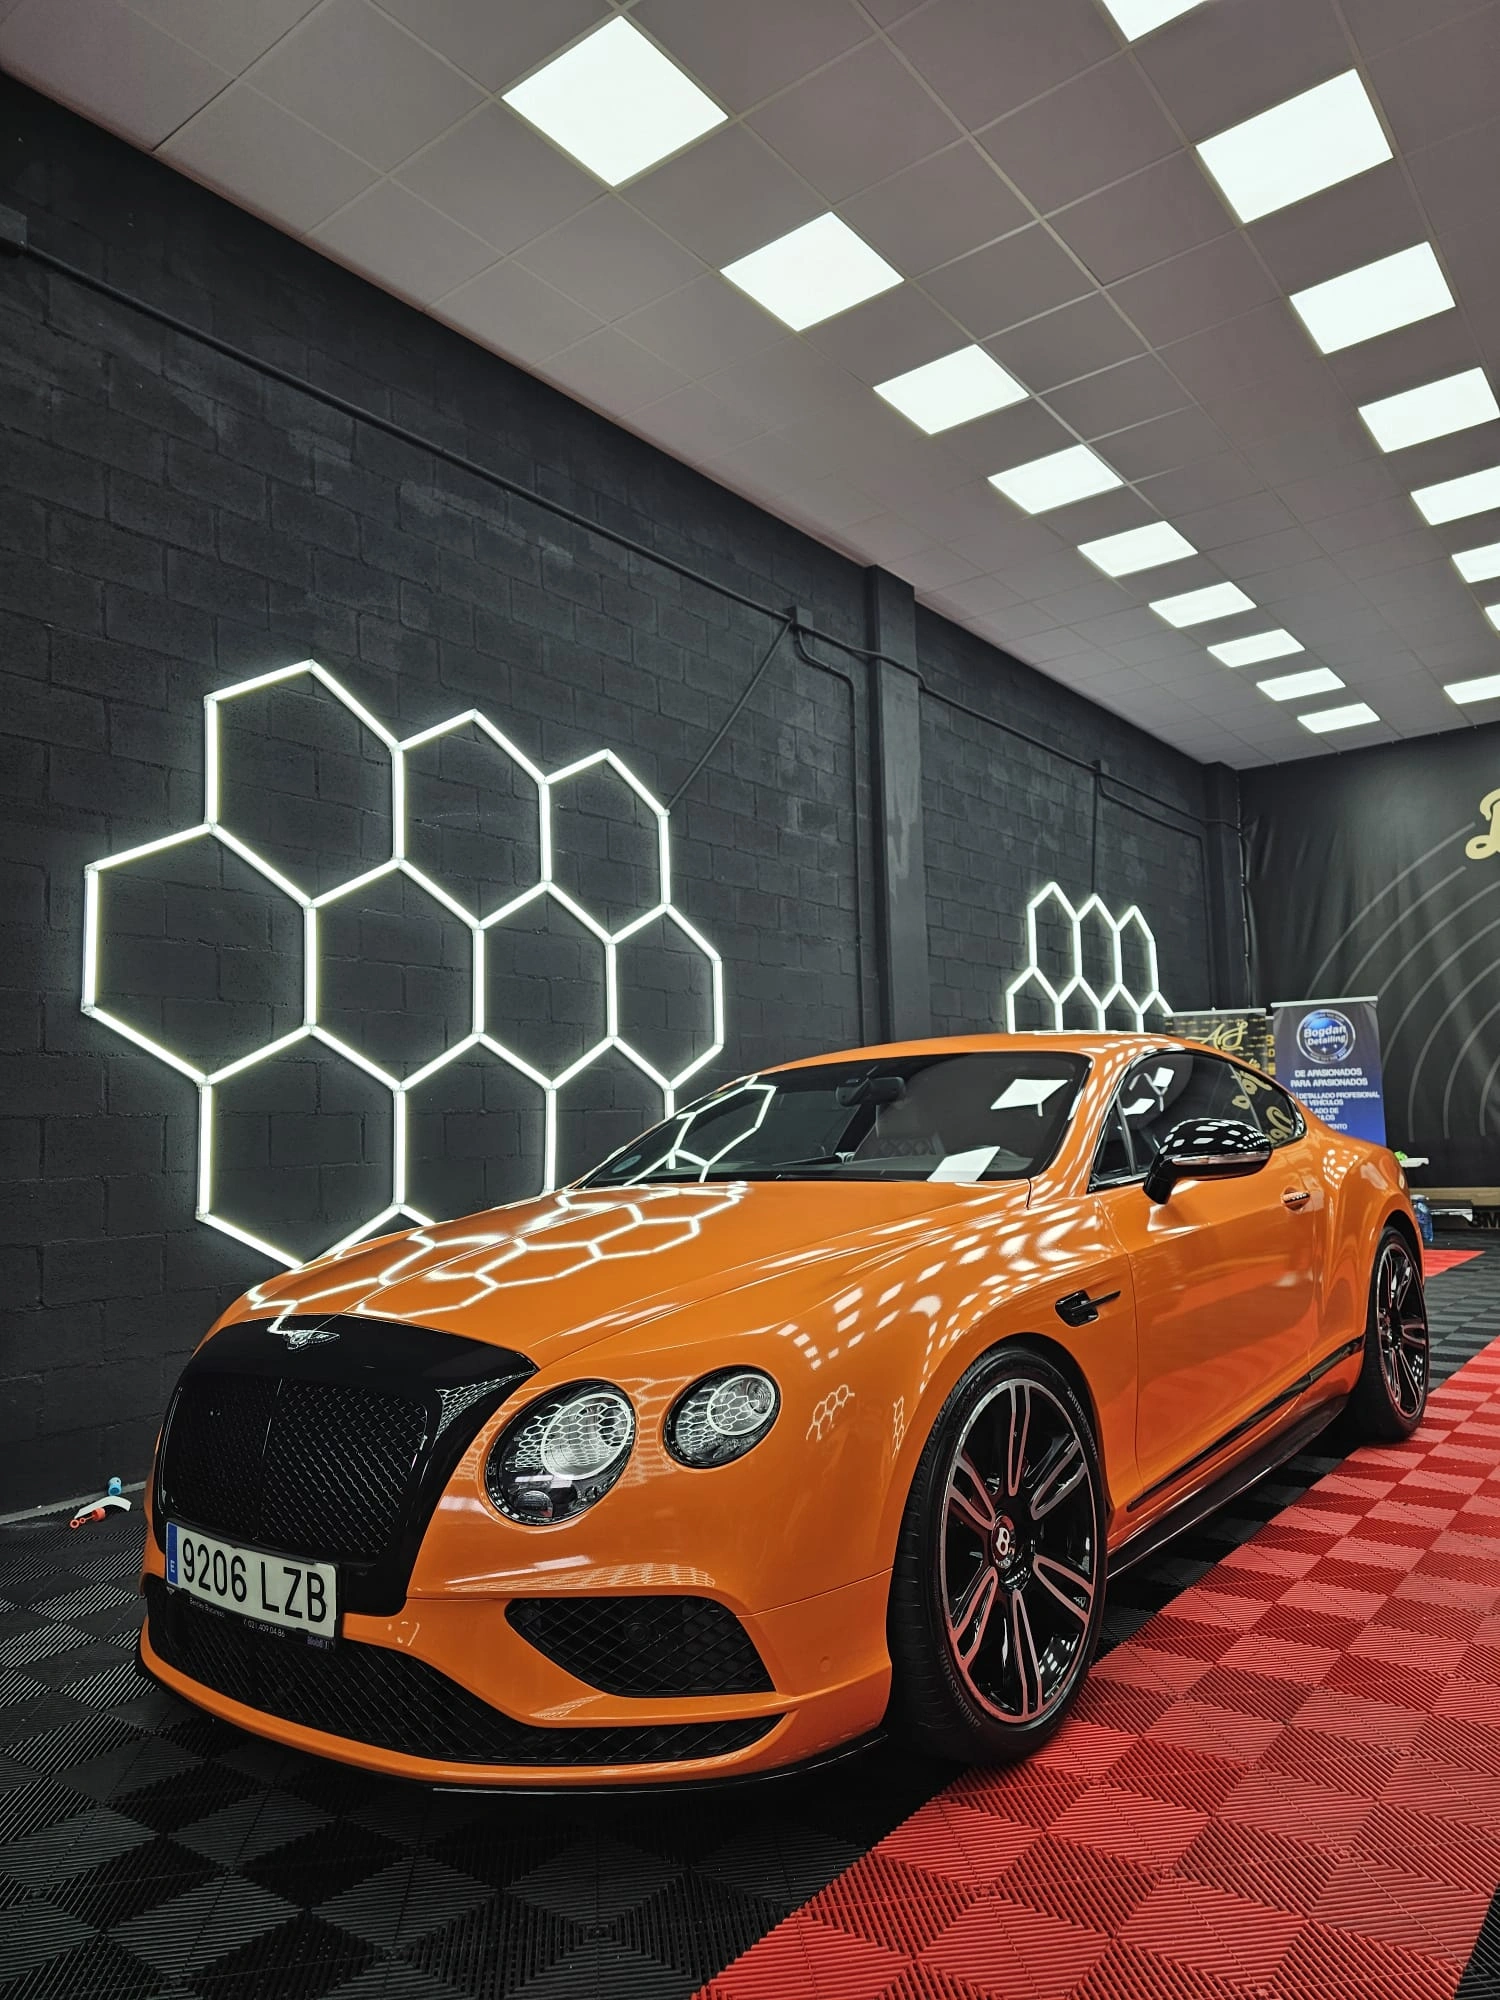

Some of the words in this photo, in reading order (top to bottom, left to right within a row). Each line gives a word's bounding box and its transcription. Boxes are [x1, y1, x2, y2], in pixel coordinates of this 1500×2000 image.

[1304, 1025, 1346, 1038] Bogdan
[1307, 1034, 1346, 1046] Detailing
[1294, 1070, 1306, 1078] DE
[1307, 1067, 1363, 1077] APASIONADOS
[1290, 1079, 1311, 1087] PARA
[1313, 1077, 1369, 1087] APASIONADOS
[1336, 1091, 1380, 1099] PROFESIONAL
[170, 1559, 175, 1573] E
[182, 1537, 248, 1603] 9206
[260, 1561, 328, 1623] LZB
